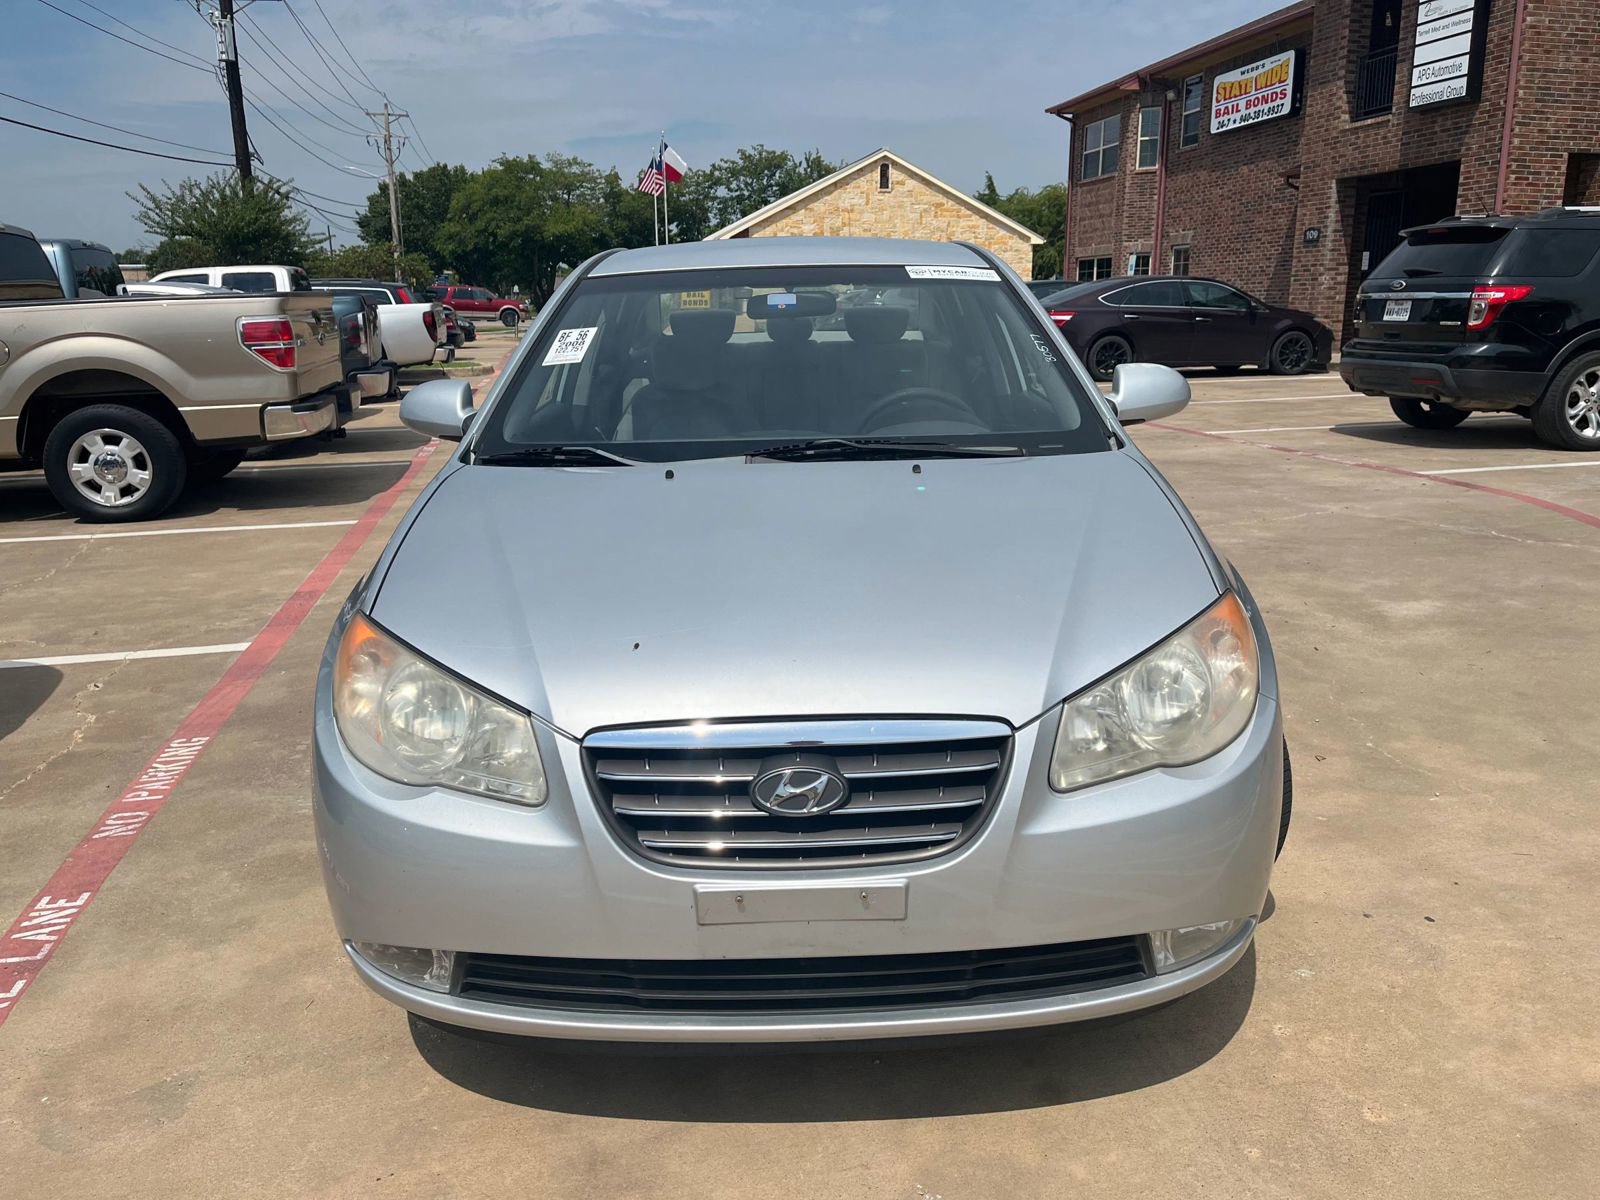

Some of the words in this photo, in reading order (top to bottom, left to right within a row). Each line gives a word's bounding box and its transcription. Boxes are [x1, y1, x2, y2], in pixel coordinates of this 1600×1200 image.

[1431, 25, 1440, 34] Med
[1240, 62, 1266, 76] WEBB'S
[1417, 67, 1430, 81] APG
[1431, 61, 1463, 78] Automotive
[1216, 77, 1253, 103] STATE
[1254, 57, 1290, 91] WIDE
[1215, 103, 1241, 119] BAIL
[1245, 88, 1287, 110] BONDS
[1411, 87, 1445, 105] Professional
[1446, 85, 1464, 98] Group
[1216, 118, 1231, 131] 24-7
[1239, 103, 1284, 124] 940-381-9937
[1306, 230, 1318, 240] 109
[558, 332, 573, 342] BF
[576, 330, 589, 340] 56
[0, 892, 91, 964] LANE
[92, 811, 149, 839] NO
[122, 737, 210, 802] PARKING
